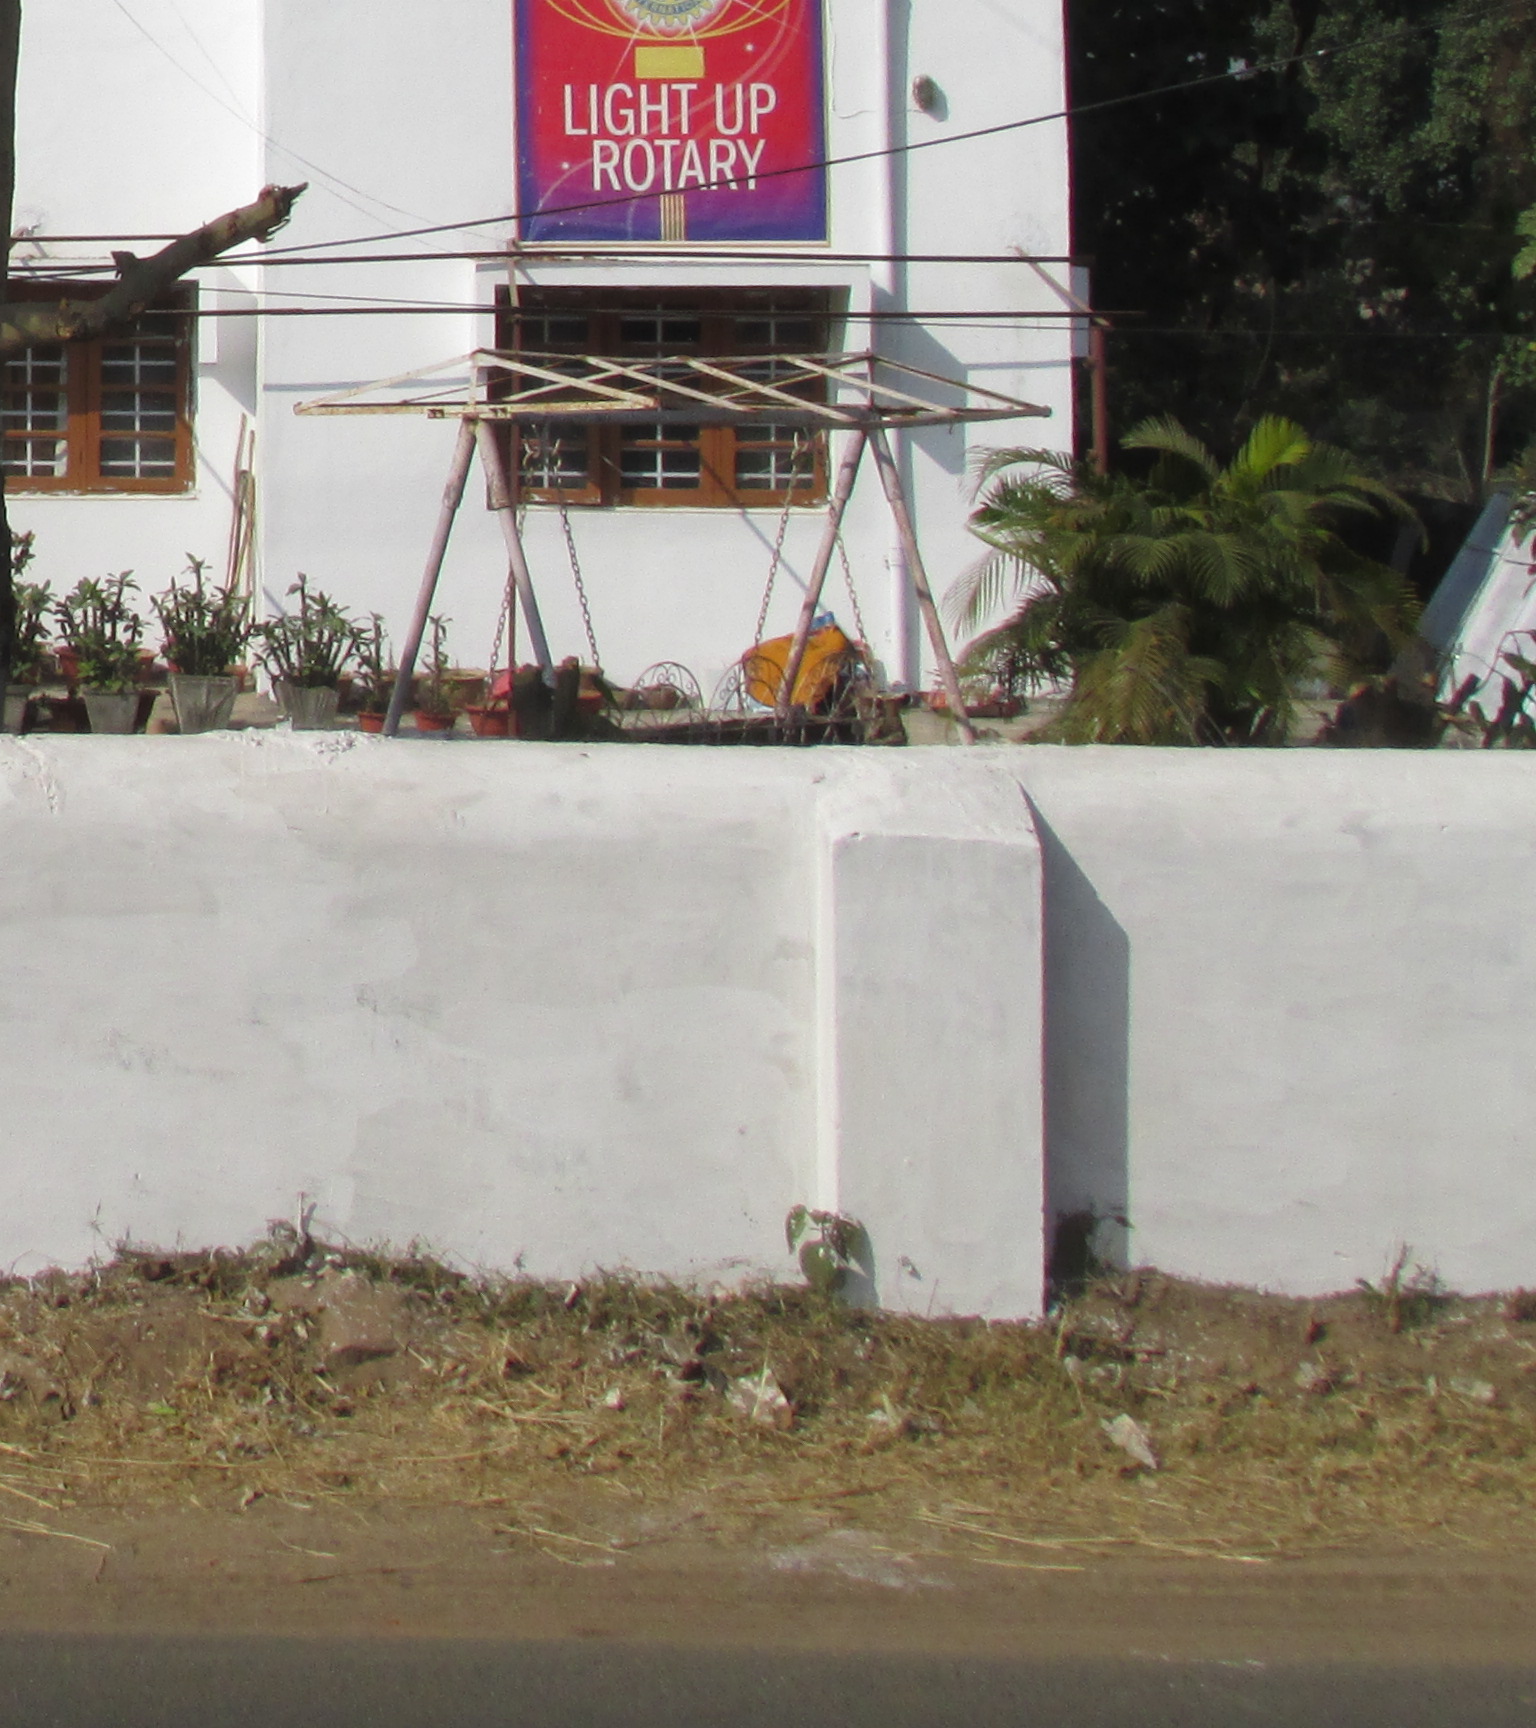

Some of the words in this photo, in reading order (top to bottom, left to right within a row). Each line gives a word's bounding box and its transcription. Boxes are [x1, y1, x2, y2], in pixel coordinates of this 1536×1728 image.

[562, 83, 697, 135] LIGHT
[715, 83, 776, 135] UP
[592, 139, 765, 191] ROTARY
